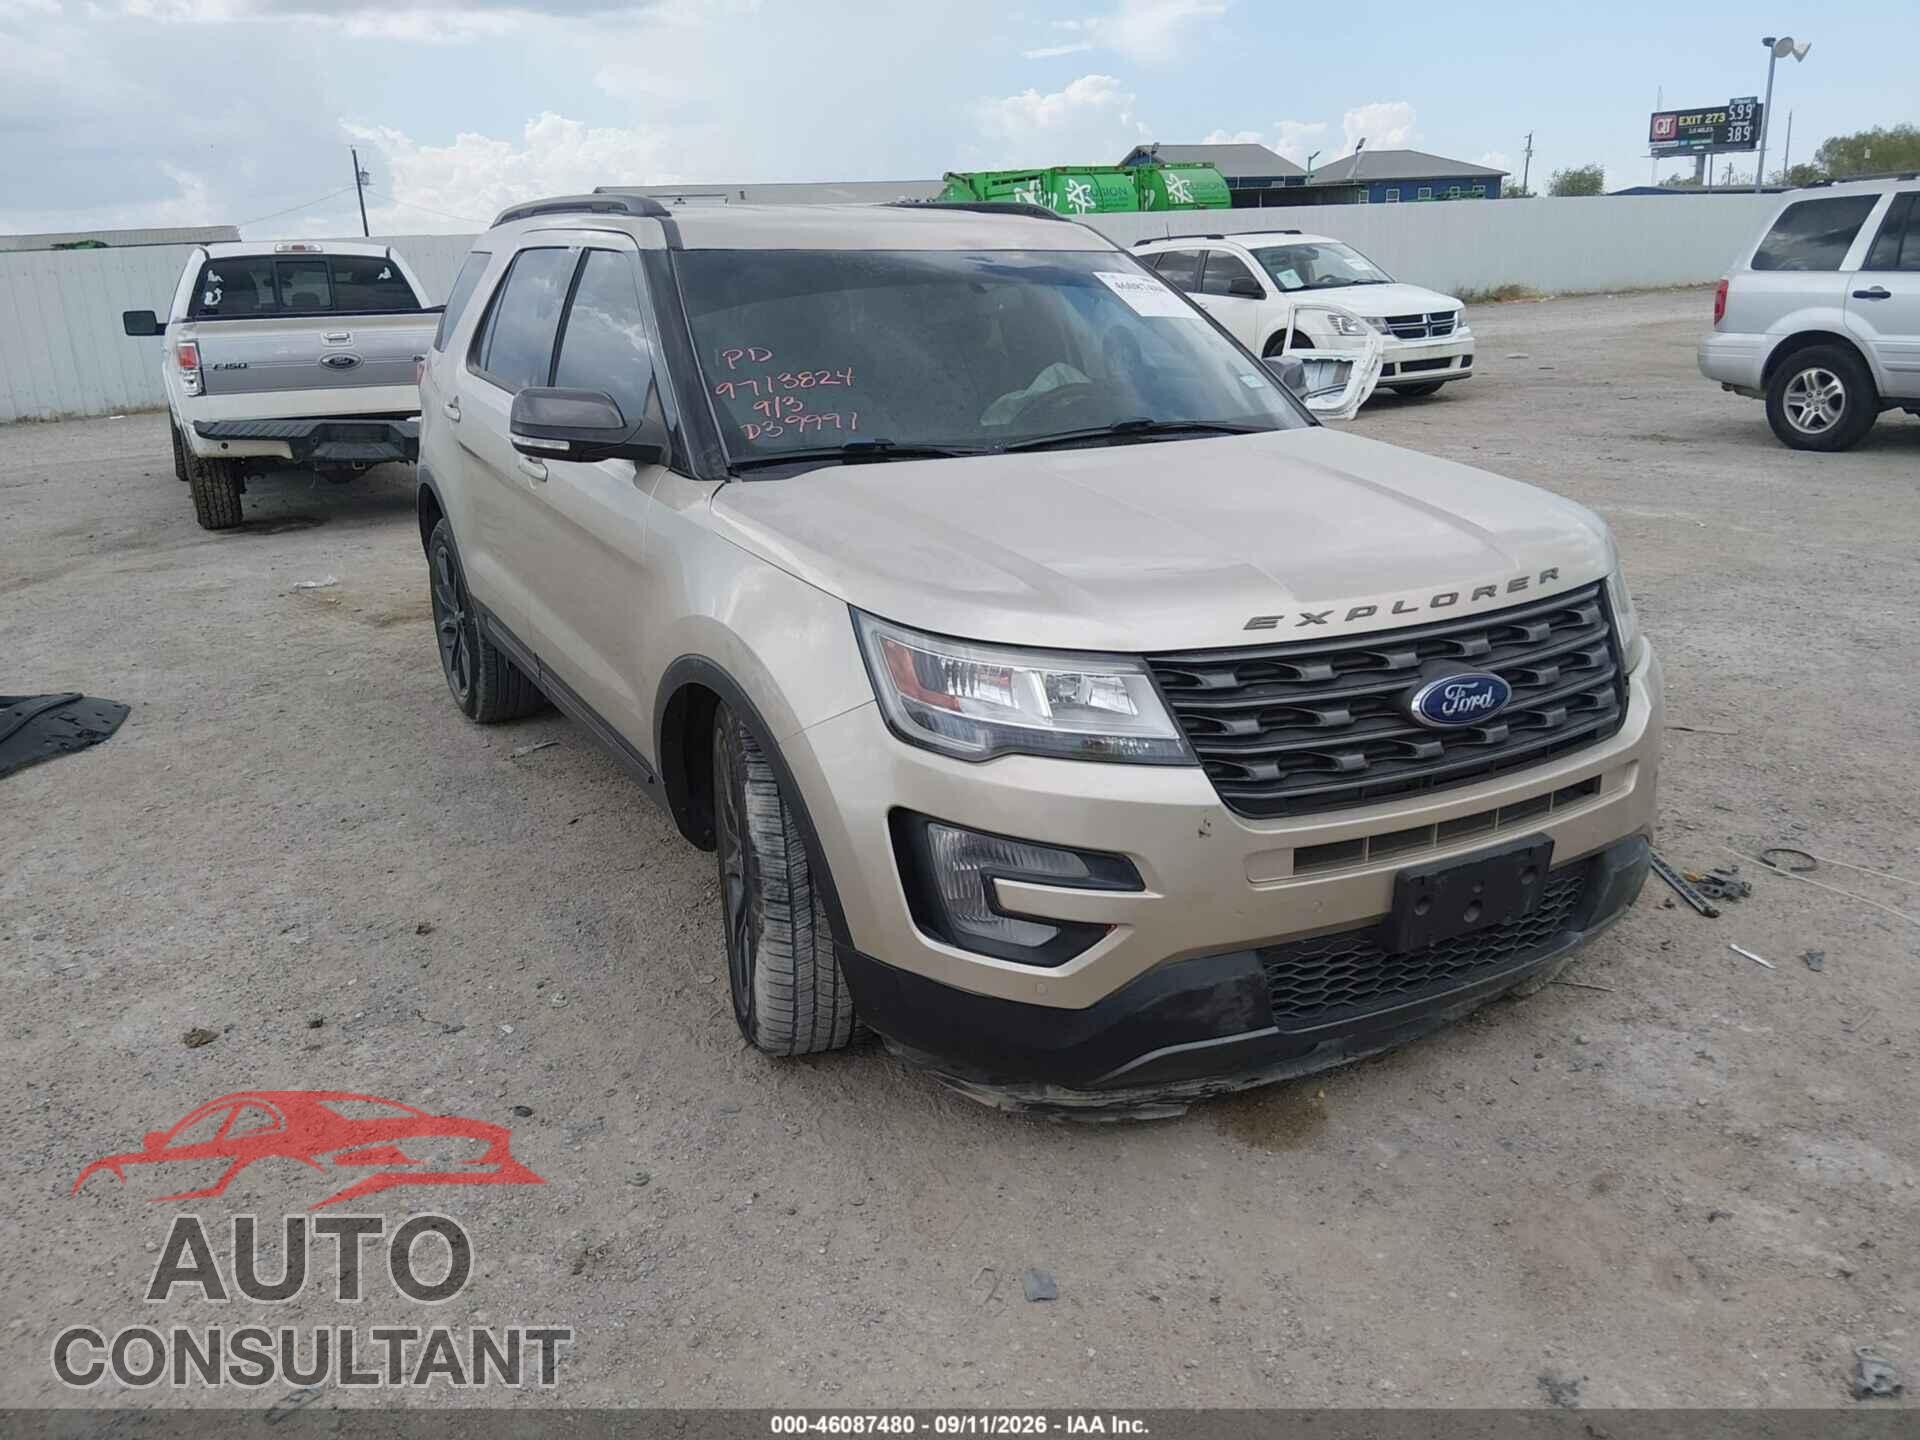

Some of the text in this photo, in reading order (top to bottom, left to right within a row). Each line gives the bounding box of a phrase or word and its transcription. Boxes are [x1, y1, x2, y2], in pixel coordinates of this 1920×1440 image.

[1655, 119, 1673, 135] QT
[1678, 115, 1703, 126] EXIT
[1704, 112, 1726, 124] 273
[722, 347, 773, 370] PD
[715, 367, 854, 399] 9713824
[1243, 567, 1560, 631] EXPLORER
[1442, 682, 1495, 716] Ford
